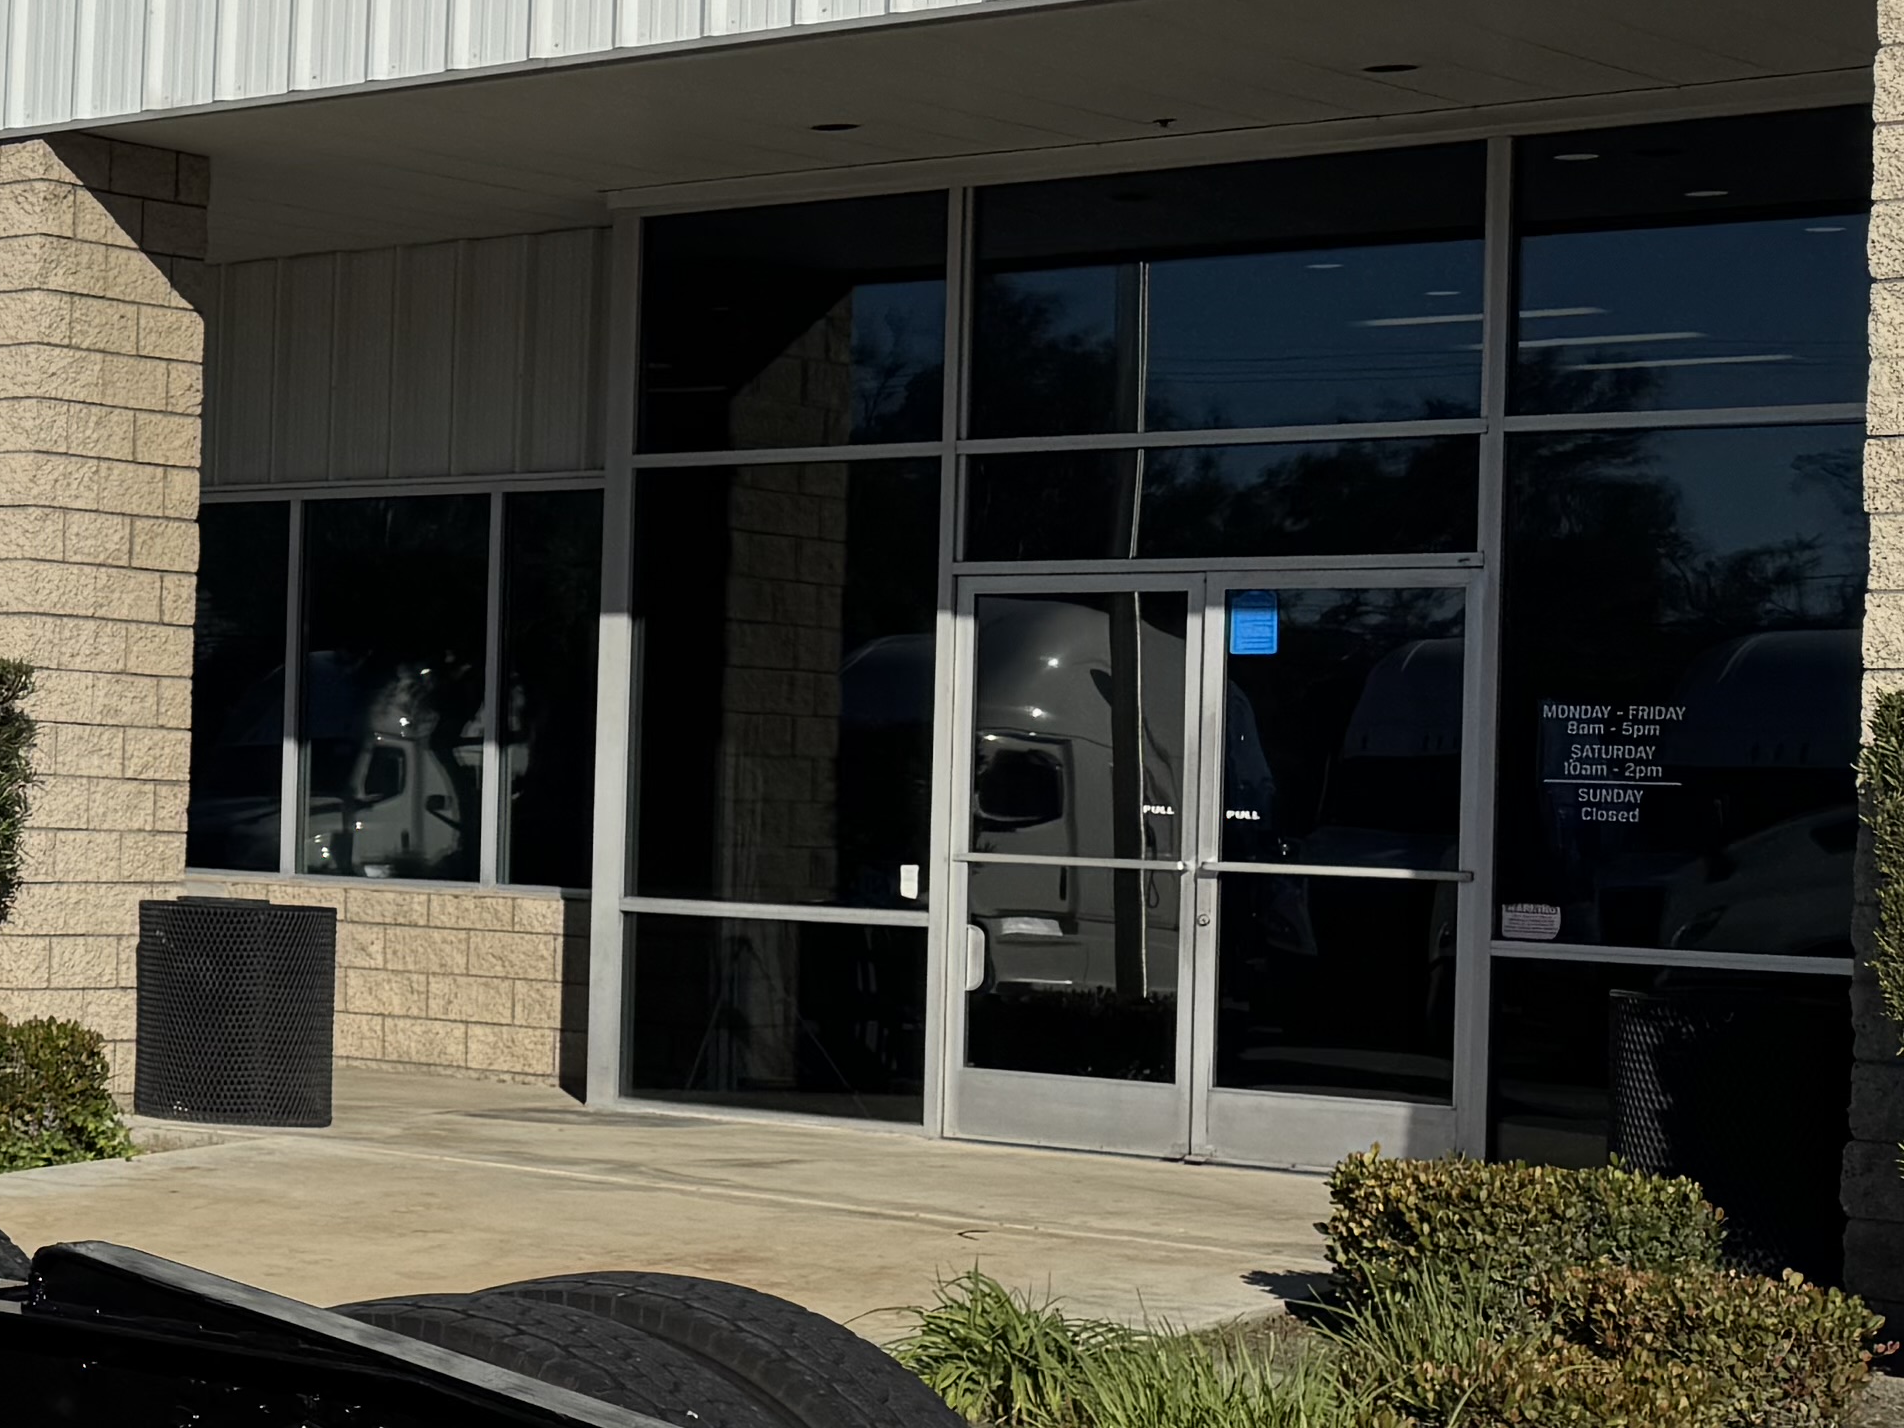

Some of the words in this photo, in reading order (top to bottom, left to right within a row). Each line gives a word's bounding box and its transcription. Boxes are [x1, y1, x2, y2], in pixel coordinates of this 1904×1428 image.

[1543, 704, 1612, 719] MONDAY
[1628, 705, 1687, 721] FRIDAY
[1567, 721, 1605, 735] 8am
[1622, 721, 1661, 738] 5pm
[1570, 744, 1657, 760] SATURDAY
[1563, 761, 1608, 777] 10am
[1624, 762, 1663, 780] 2pm
[1578, 788, 1644, 803] SUNDAY
[1142, 804, 1175, 816] PULL
[1225, 809, 1261, 821] PULL
[1581, 807, 1640, 822] Closed
